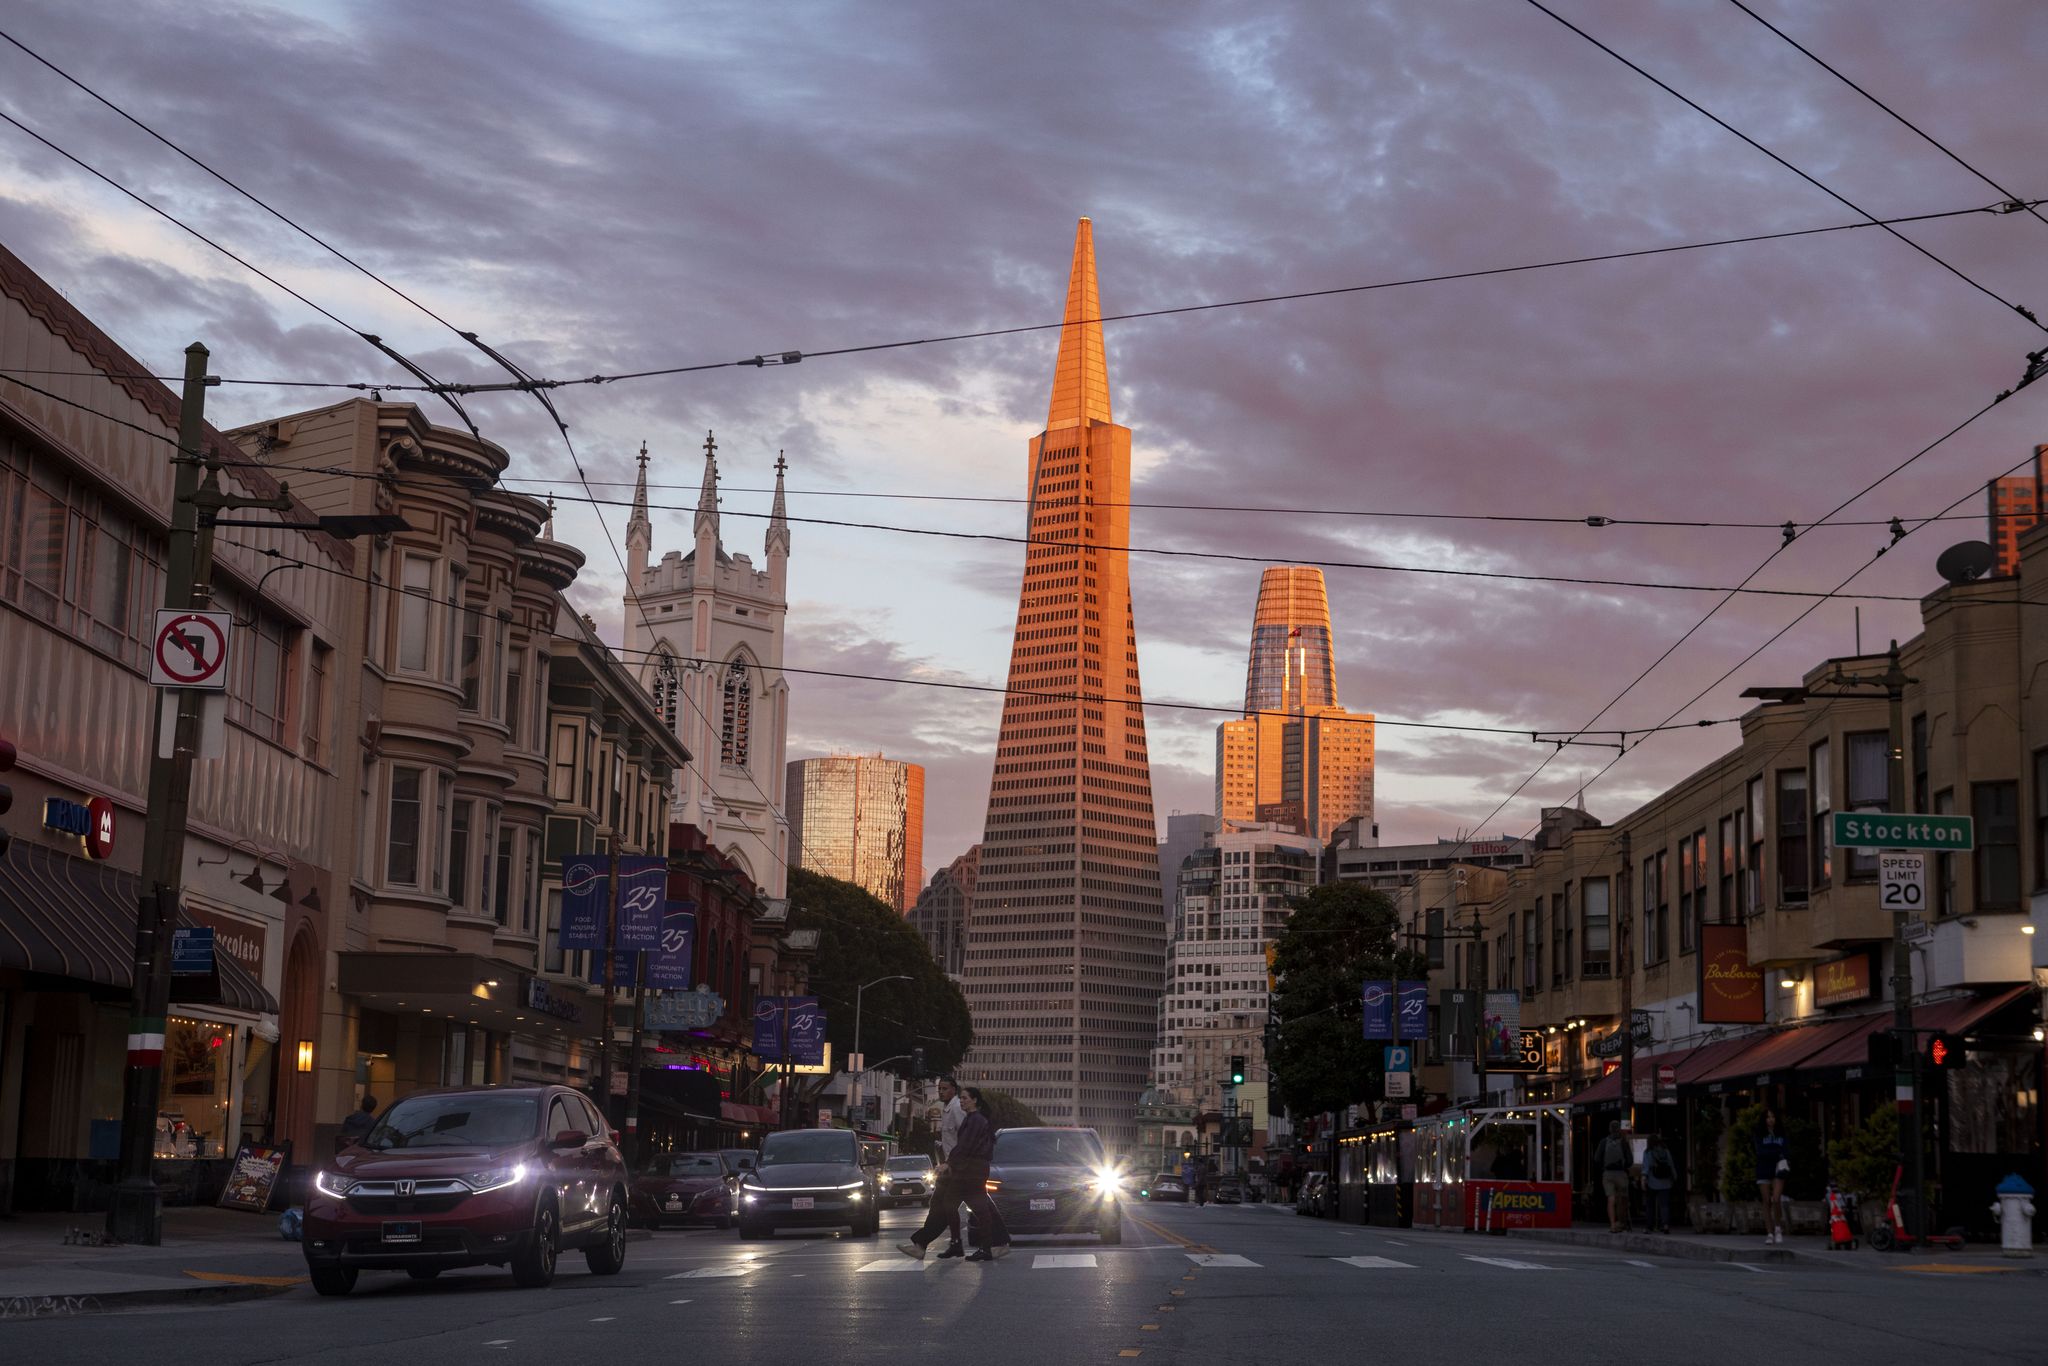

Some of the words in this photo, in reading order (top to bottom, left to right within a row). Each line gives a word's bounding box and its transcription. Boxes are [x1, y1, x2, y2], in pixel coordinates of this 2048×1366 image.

[1844, 820, 1963, 842] Stockton
[1471, 842, 1508, 855] Hilton
[1882, 859, 1922, 869] SPEED
[1886, 871, 1918, 881] LIMIT
[622, 886, 661, 912] 25
[1884, 883, 1921, 905] 20
[661, 928, 688, 952] 25
[650, 964, 685, 972] COMMUNITY
[1704, 963, 1762, 980] Barbara
[1401, 999, 1425, 1015] 25
[791, 1014, 816, 1031] 25
[1631, 1012, 1647, 1021] HOE
[1491, 1191, 1546, 1209] APEROL
